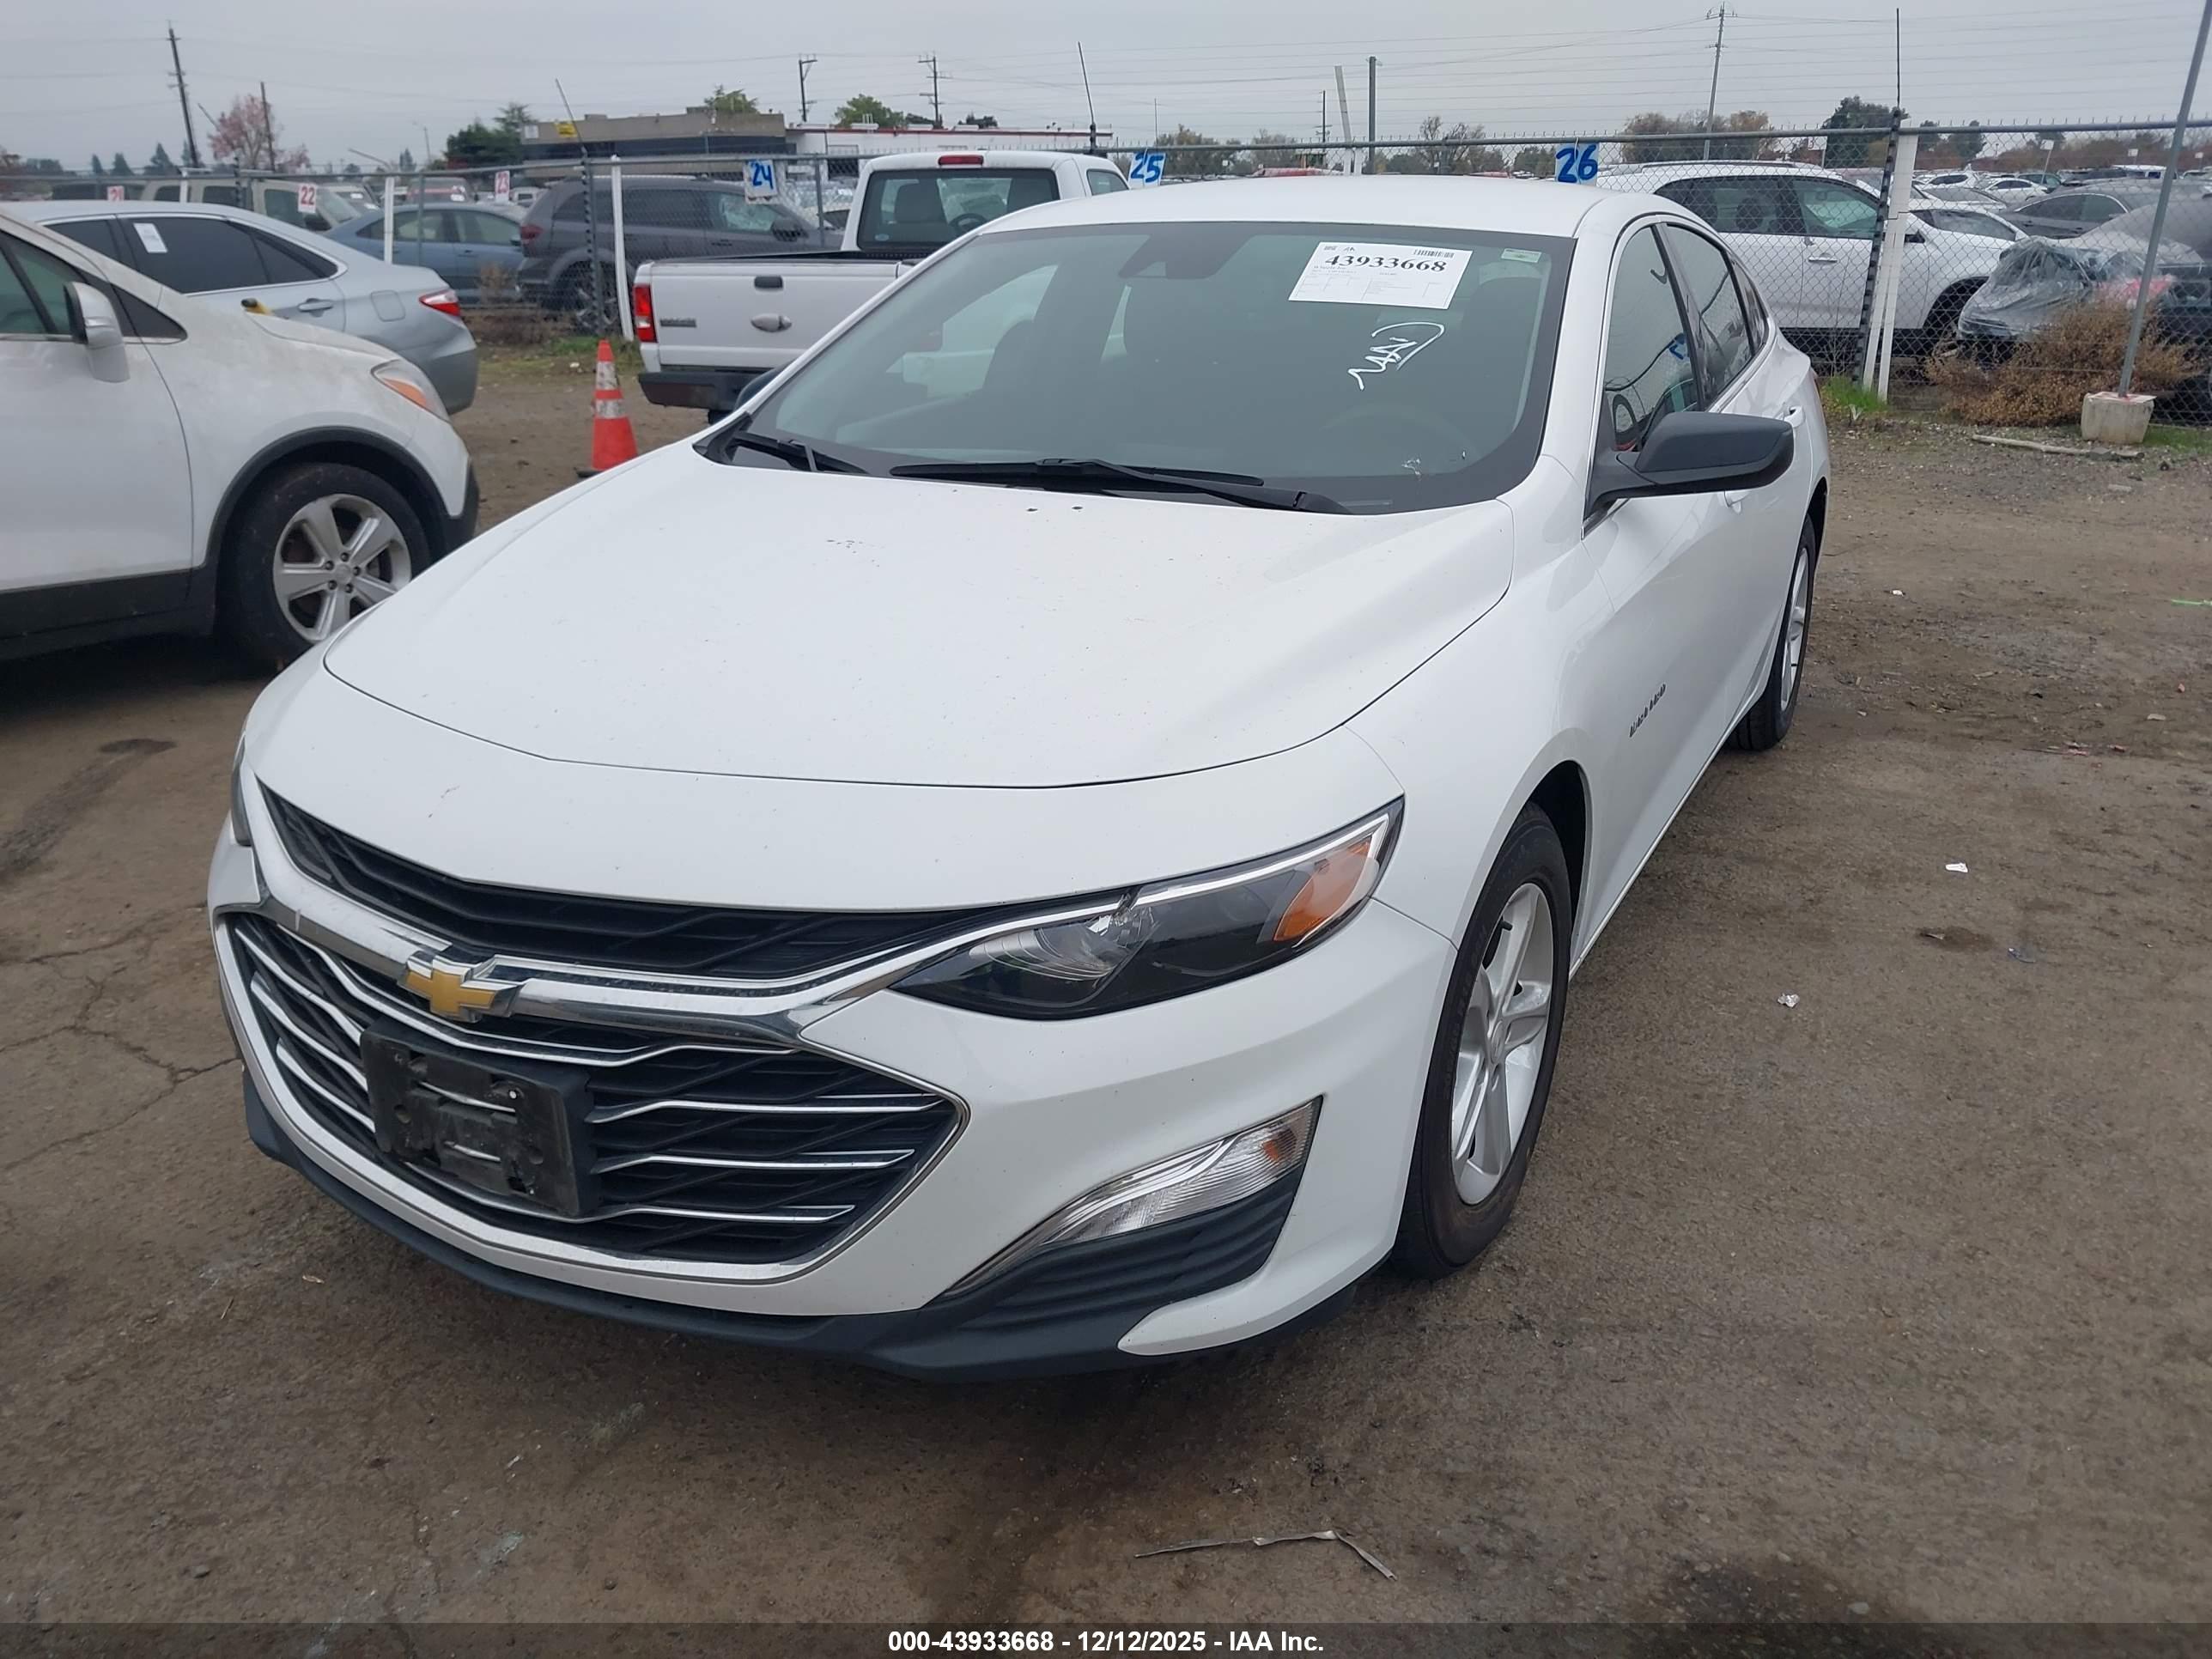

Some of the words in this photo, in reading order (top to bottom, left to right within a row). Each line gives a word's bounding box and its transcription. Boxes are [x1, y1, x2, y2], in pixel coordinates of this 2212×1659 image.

[751, 162, 774, 190] 24
[1130, 151, 1164, 183] 25
[1555, 143, 1598, 183] 26
[301, 185, 315, 206] 22
[1325, 255, 1447, 272] 43933668
